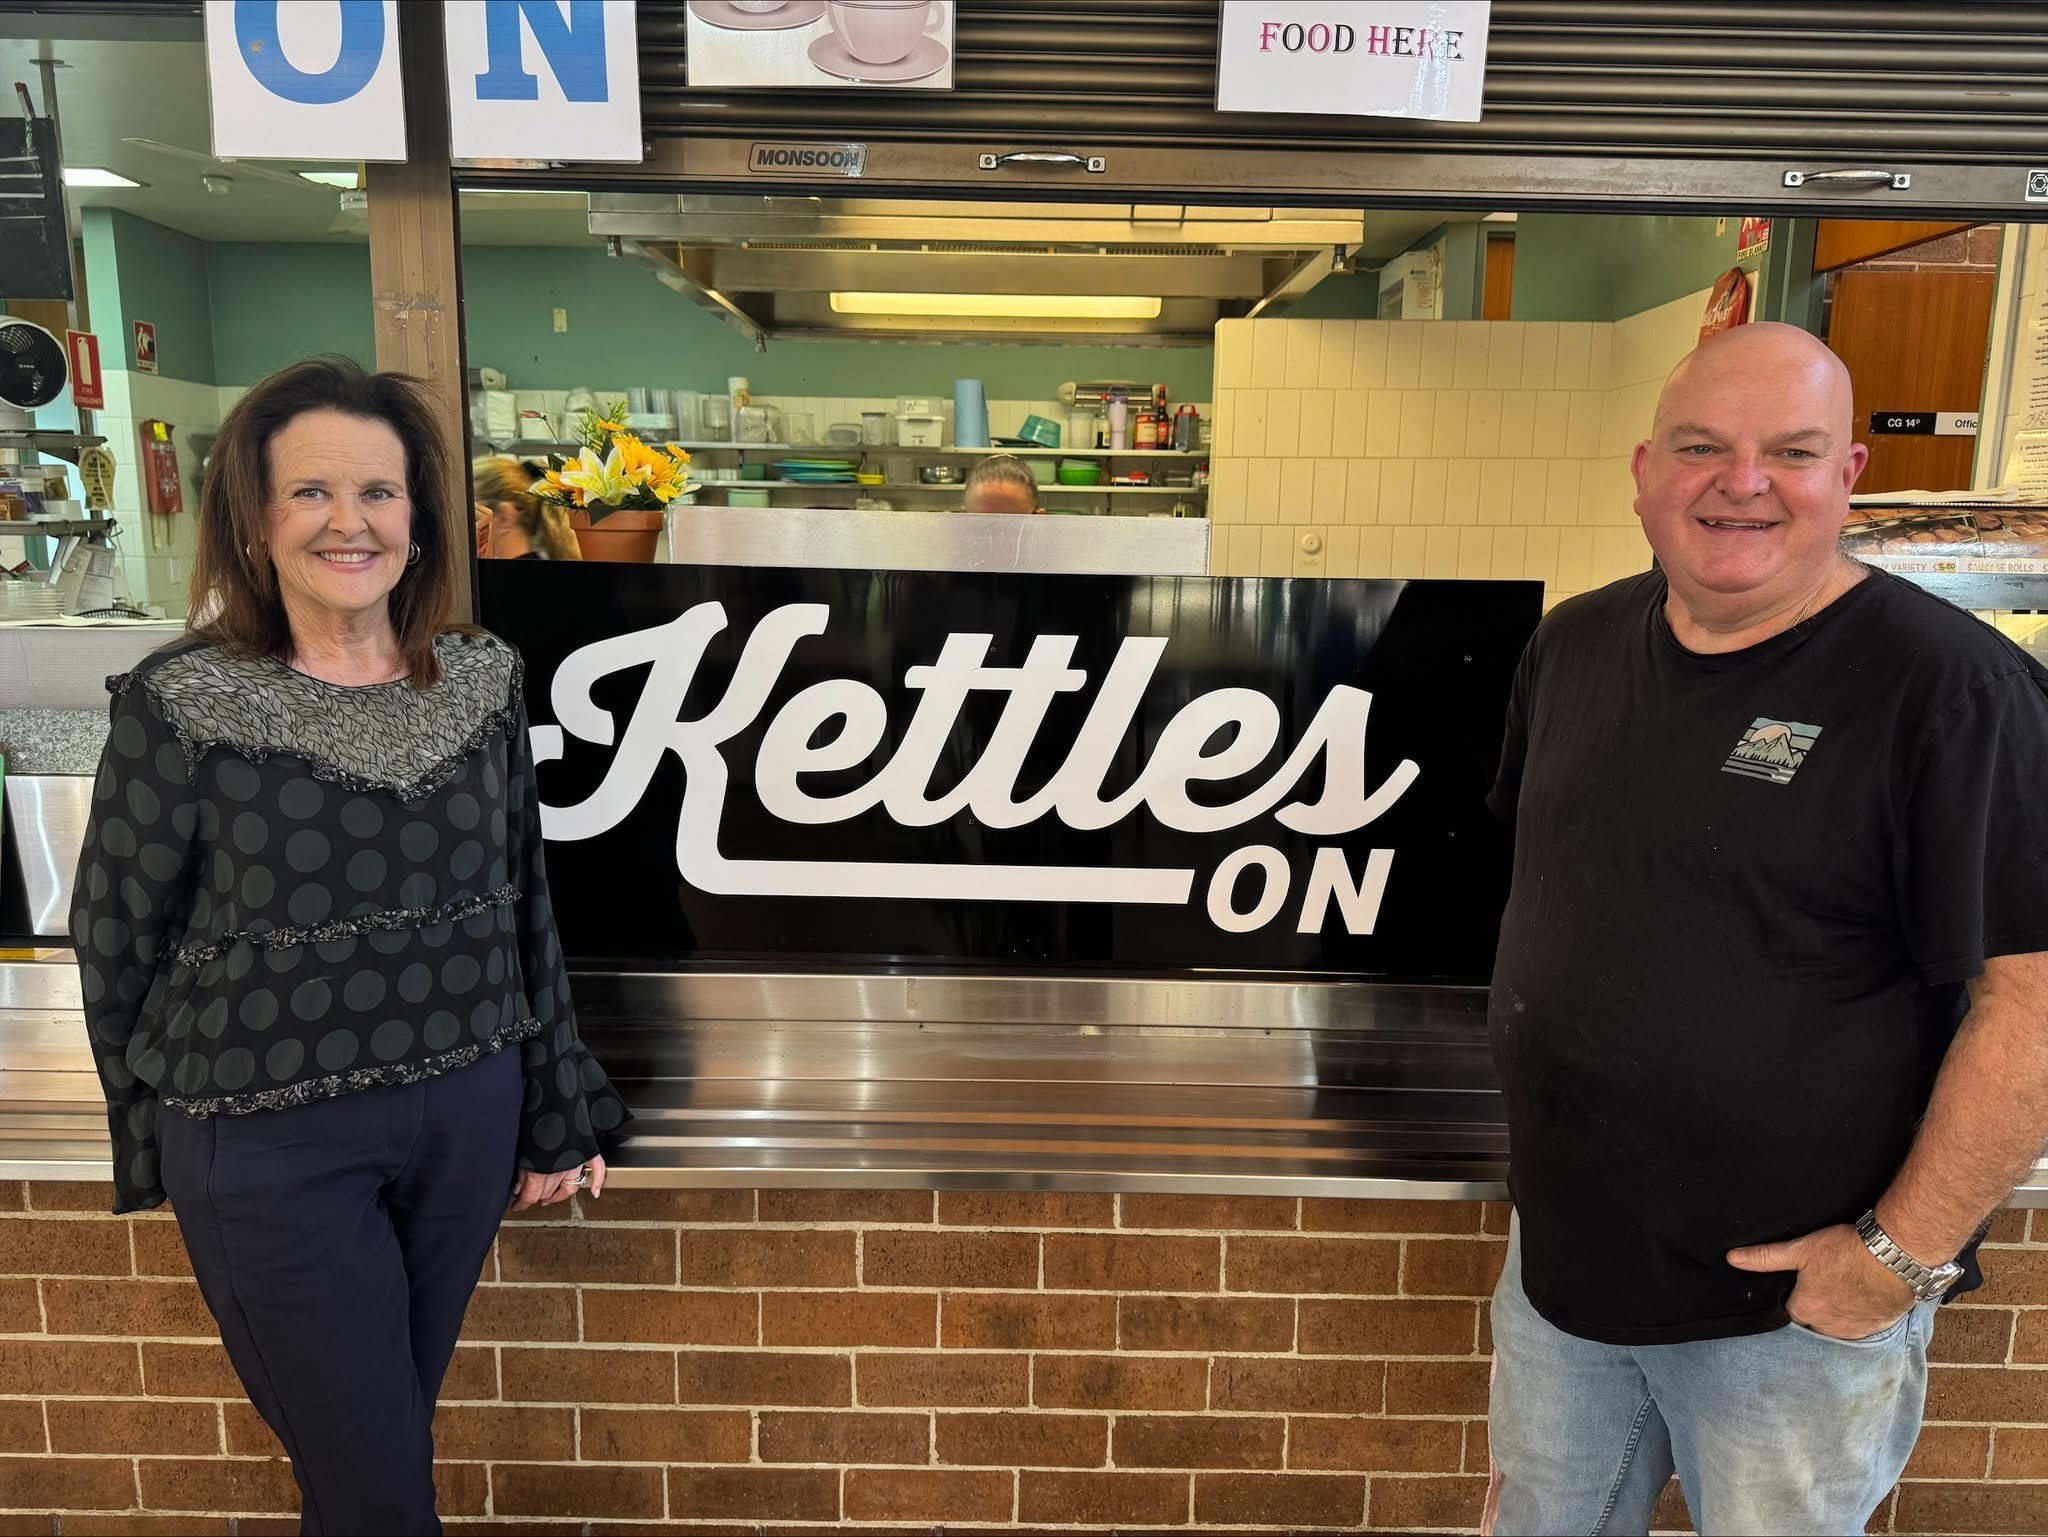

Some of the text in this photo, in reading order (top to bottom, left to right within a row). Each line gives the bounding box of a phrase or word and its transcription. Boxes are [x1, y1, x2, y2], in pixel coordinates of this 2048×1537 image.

[1258, 22, 1465, 61] FOOD HERE
[757, 149, 859, 168] MONSOON
[1887, 418, 1903, 428] CG
[1954, 419, 1978, 429] Offic
[1967, 563, 2005, 572] SAUSAGE
[2008, 563, 2034, 572] ROLLS
[529, 601, 1420, 904] Kettles
[1207, 845, 1394, 935] ON
